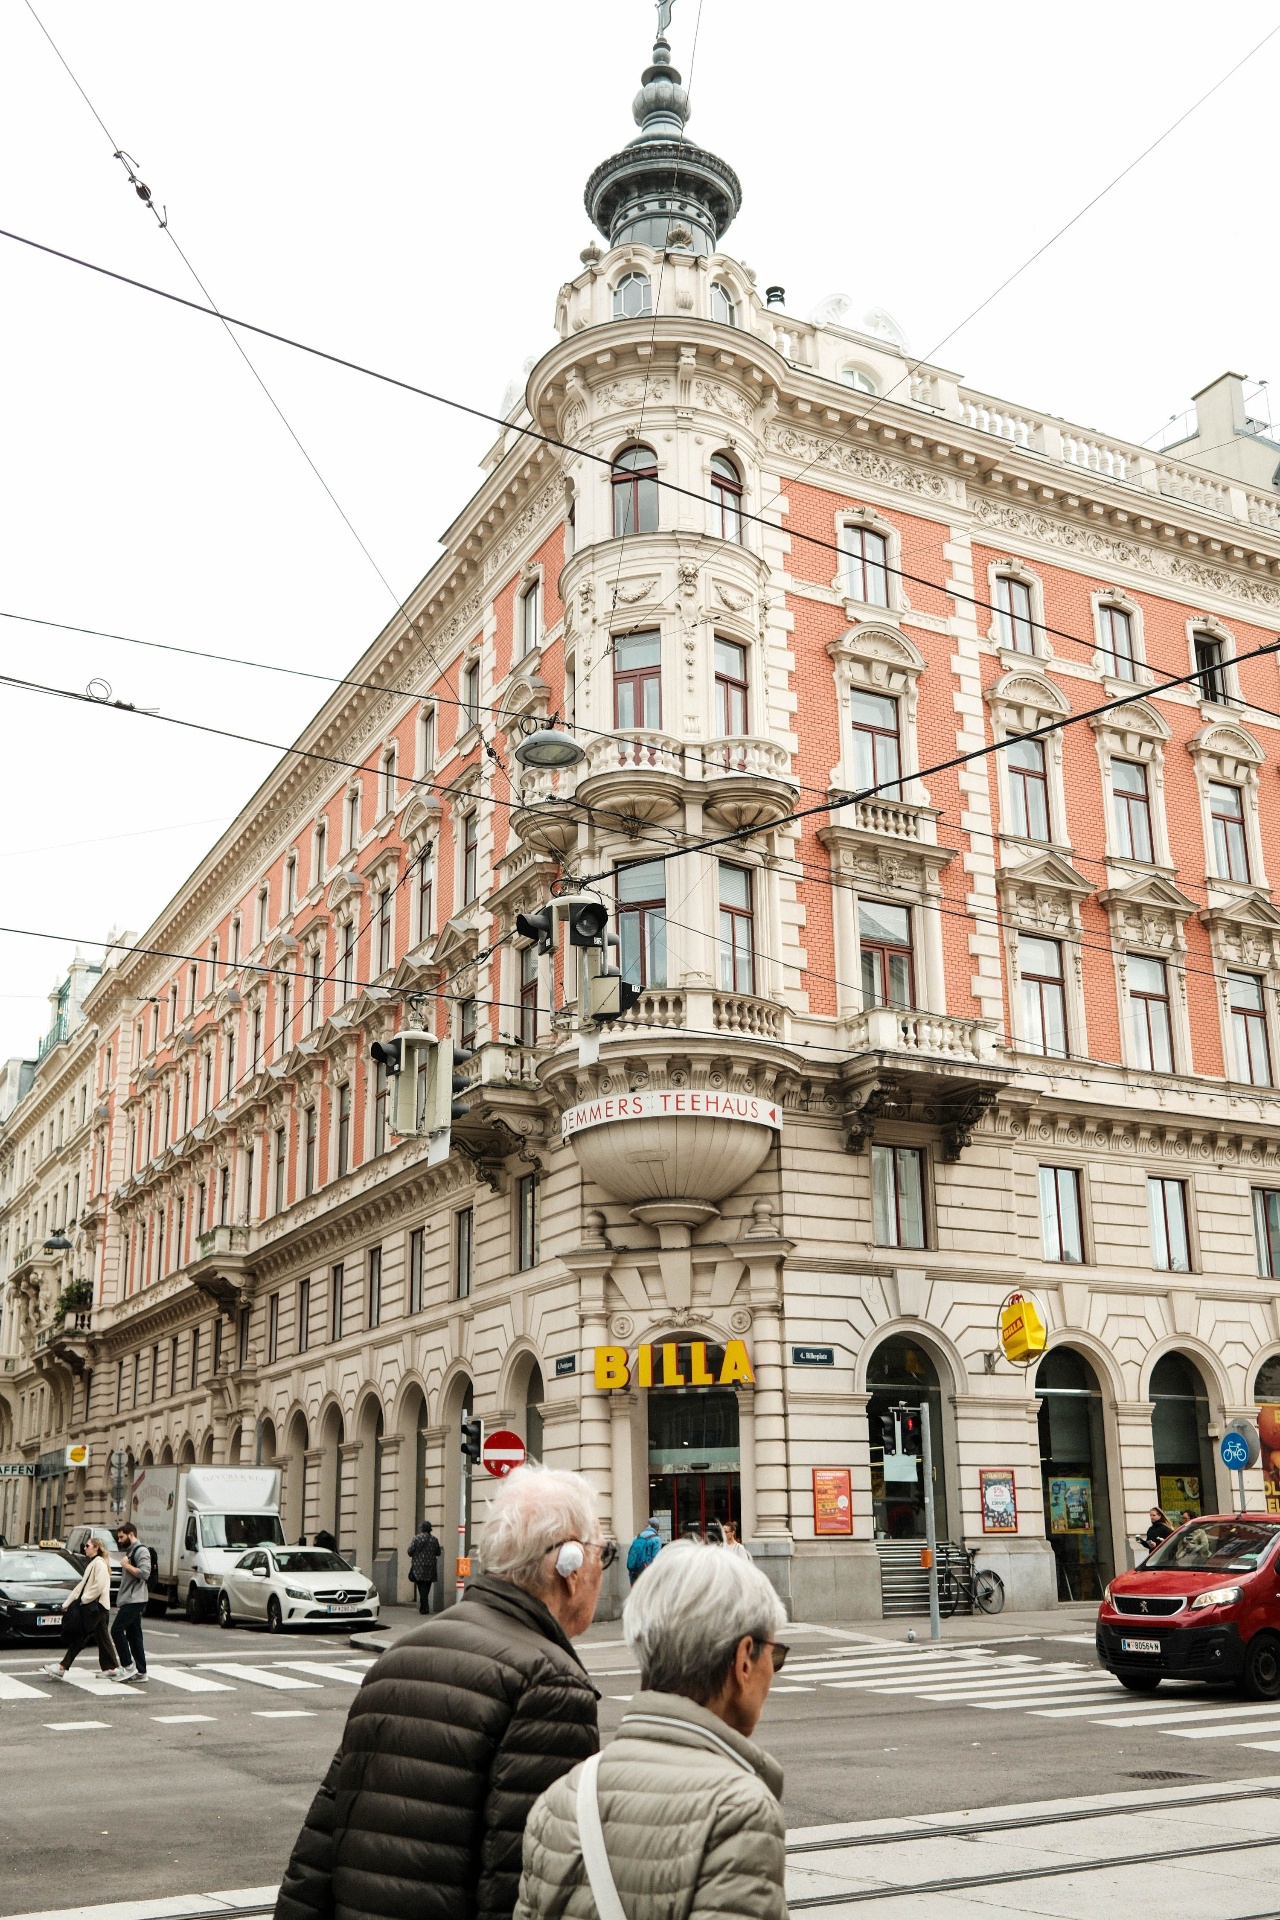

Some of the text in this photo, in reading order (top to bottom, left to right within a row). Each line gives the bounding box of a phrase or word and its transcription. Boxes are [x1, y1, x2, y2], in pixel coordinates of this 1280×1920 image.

[660, 1094, 759, 1119] TEEHAUS
[1003, 1319, 1023, 1338] BILLA
[594, 1339, 756, 1389] BILLA
